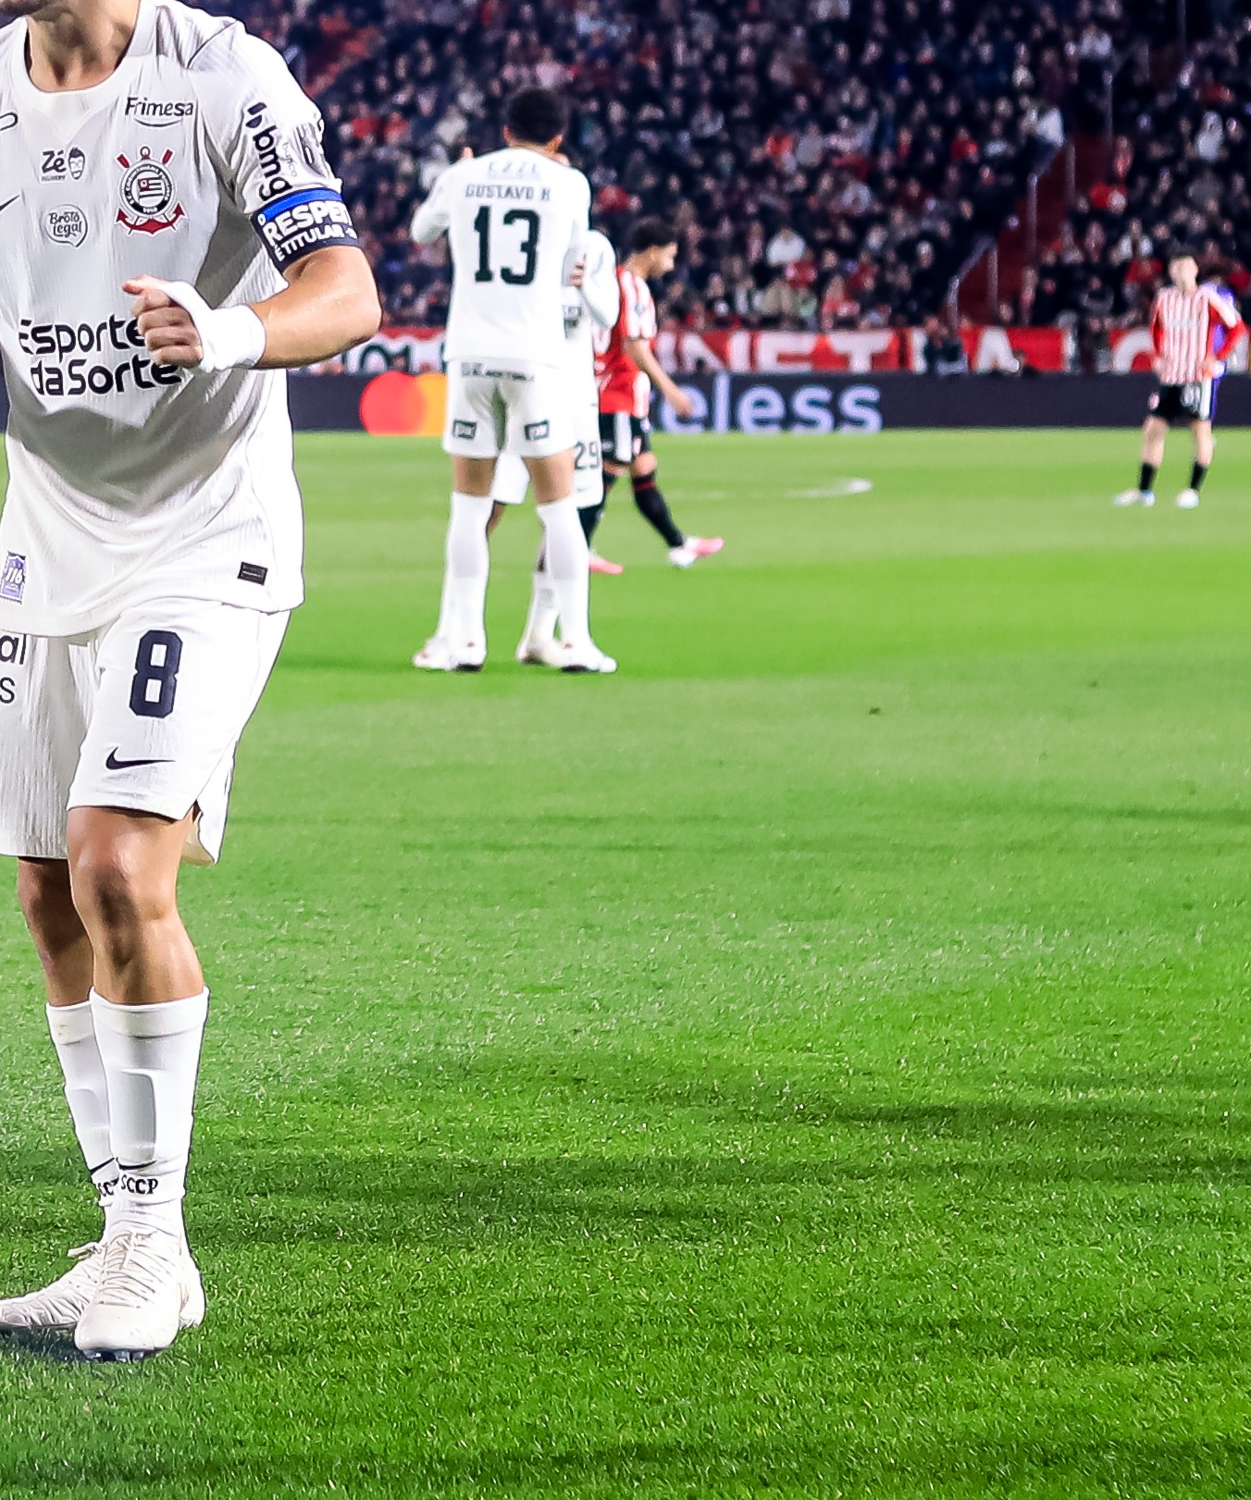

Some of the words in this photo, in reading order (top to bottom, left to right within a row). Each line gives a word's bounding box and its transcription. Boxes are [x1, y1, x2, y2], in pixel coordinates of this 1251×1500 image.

[125, 97, 194, 117] Frimesa
[41, 150, 67, 174] Zé
[252, 124, 293, 201] bmg
[282, 224, 345, 255] TITULAR
[474, 205, 540, 285] 13
[129, 629, 183, 719] 8
[121, 1174, 159, 1195] SCCP
